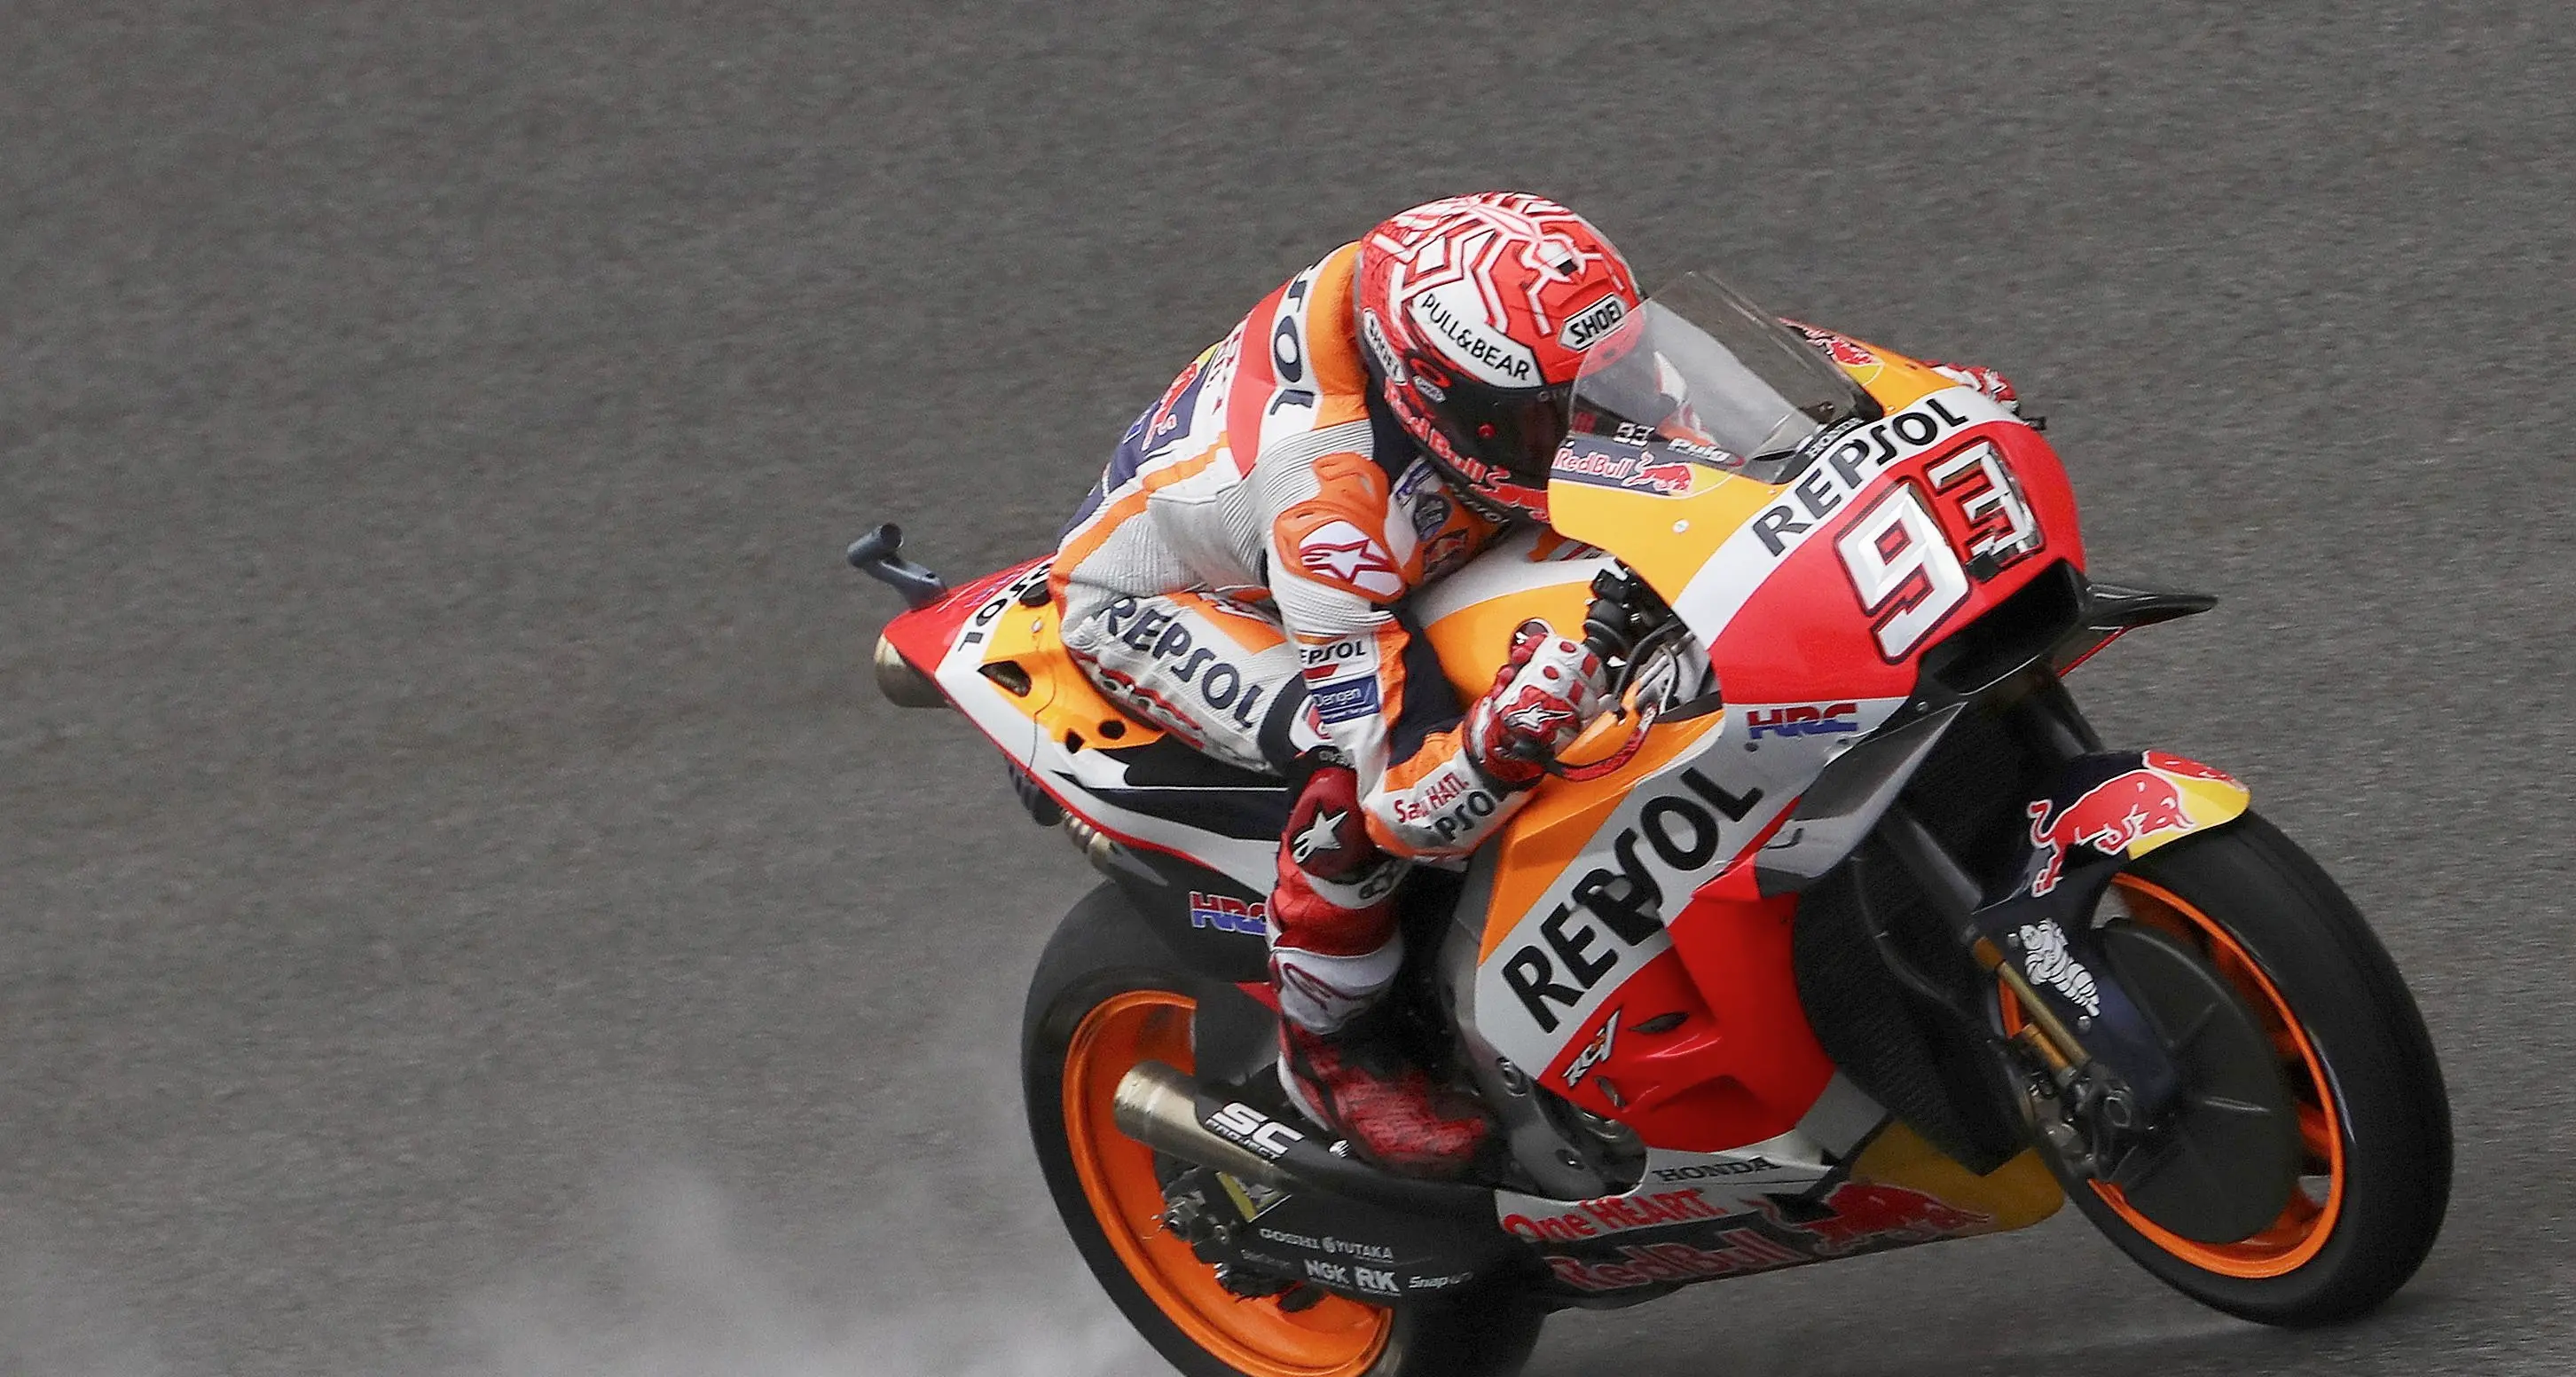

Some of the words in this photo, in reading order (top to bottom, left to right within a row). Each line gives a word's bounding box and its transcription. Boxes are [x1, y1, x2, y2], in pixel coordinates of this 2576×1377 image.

[1268, 267, 1315, 415] SOL
[1420, 293, 1531, 382] PULL&BEAR
[1570, 300, 1622, 344] SHOEI
[1613, 421, 1655, 447] 93
[1667, 437, 1732, 462] Puig
[1804, 417, 1865, 459] HONDA
[1751, 398, 1969, 557] REPSOL
[1833, 436, 2046, 665] 93
[1108, 596, 1264, 728] REPSOL
[1300, 641, 1367, 665] EPSOL
[1747, 702, 1858, 740] HRC
[1500, 766, 1764, 1034] REPSOL
[1212, 1102, 1306, 1154] SC
[1652, 1155, 1781, 1182] HONDA
[1503, 1213, 1597, 1241] One
[1303, 1258, 1350, 1285] NGK
[1355, 1265, 1402, 1293] RK
